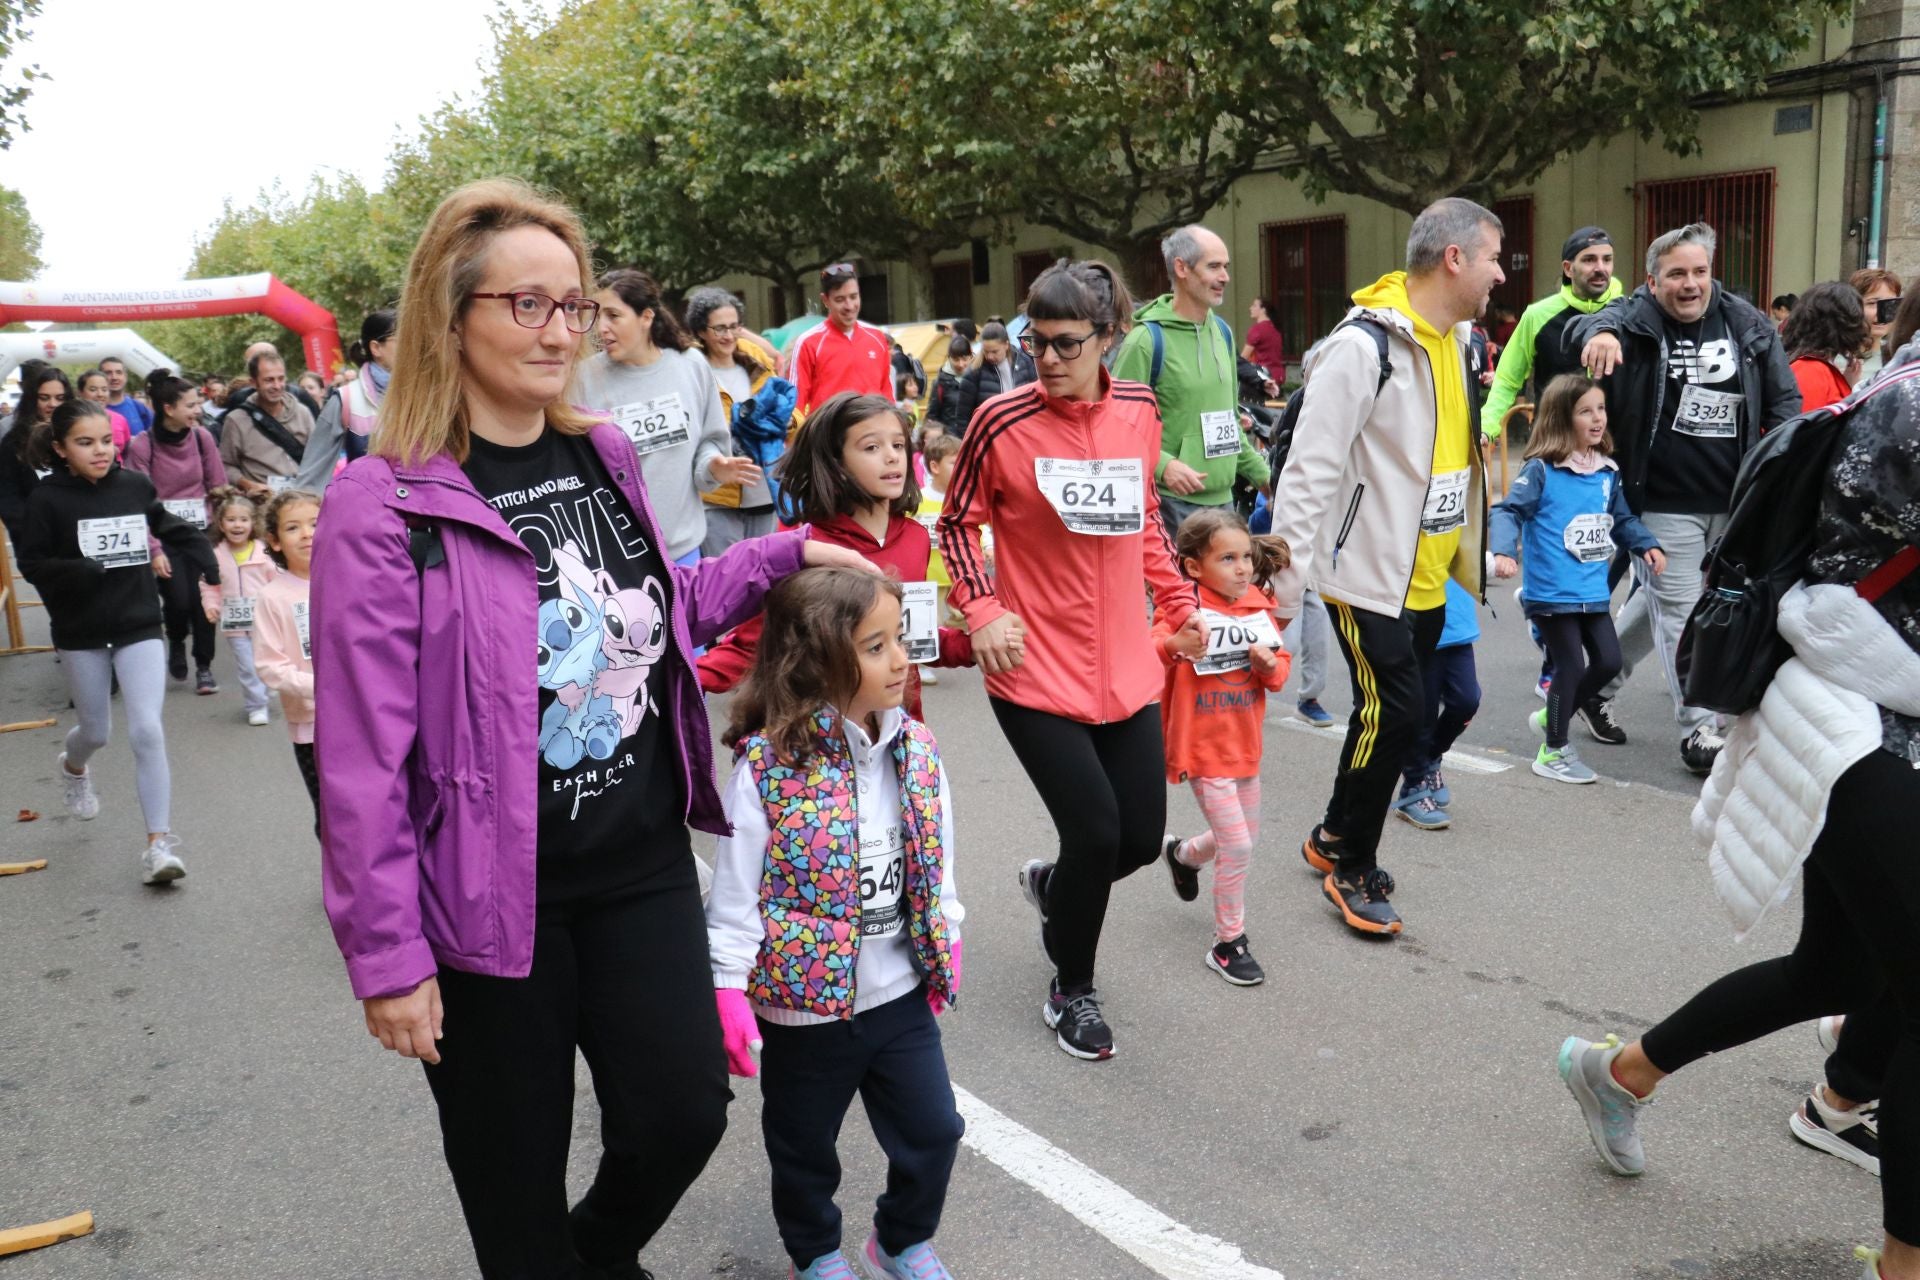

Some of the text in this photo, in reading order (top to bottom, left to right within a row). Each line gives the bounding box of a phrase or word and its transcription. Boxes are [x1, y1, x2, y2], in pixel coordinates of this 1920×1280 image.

[62, 290, 160, 302] AYUNTAMIENTO
[163, 288, 178, 300] DE
[139, 304, 152, 313] DE
[154, 303, 198, 312] DEPORTES
[1687, 402, 1729, 420] 3393
[632, 413, 669, 437] 262
[1216, 424, 1235, 440] 285
[528, 480, 557, 502] AND
[556, 475, 586, 492] ANGEL
[1062, 482, 1117, 507] 624
[1436, 489, 1463, 513] 231
[97, 532, 131, 551] 374
[508, 488, 649, 586] OVE
[1575, 528, 1606, 545] 2482
[1211, 625, 1258, 648] 700
[553, 769, 598, 792] EACH
